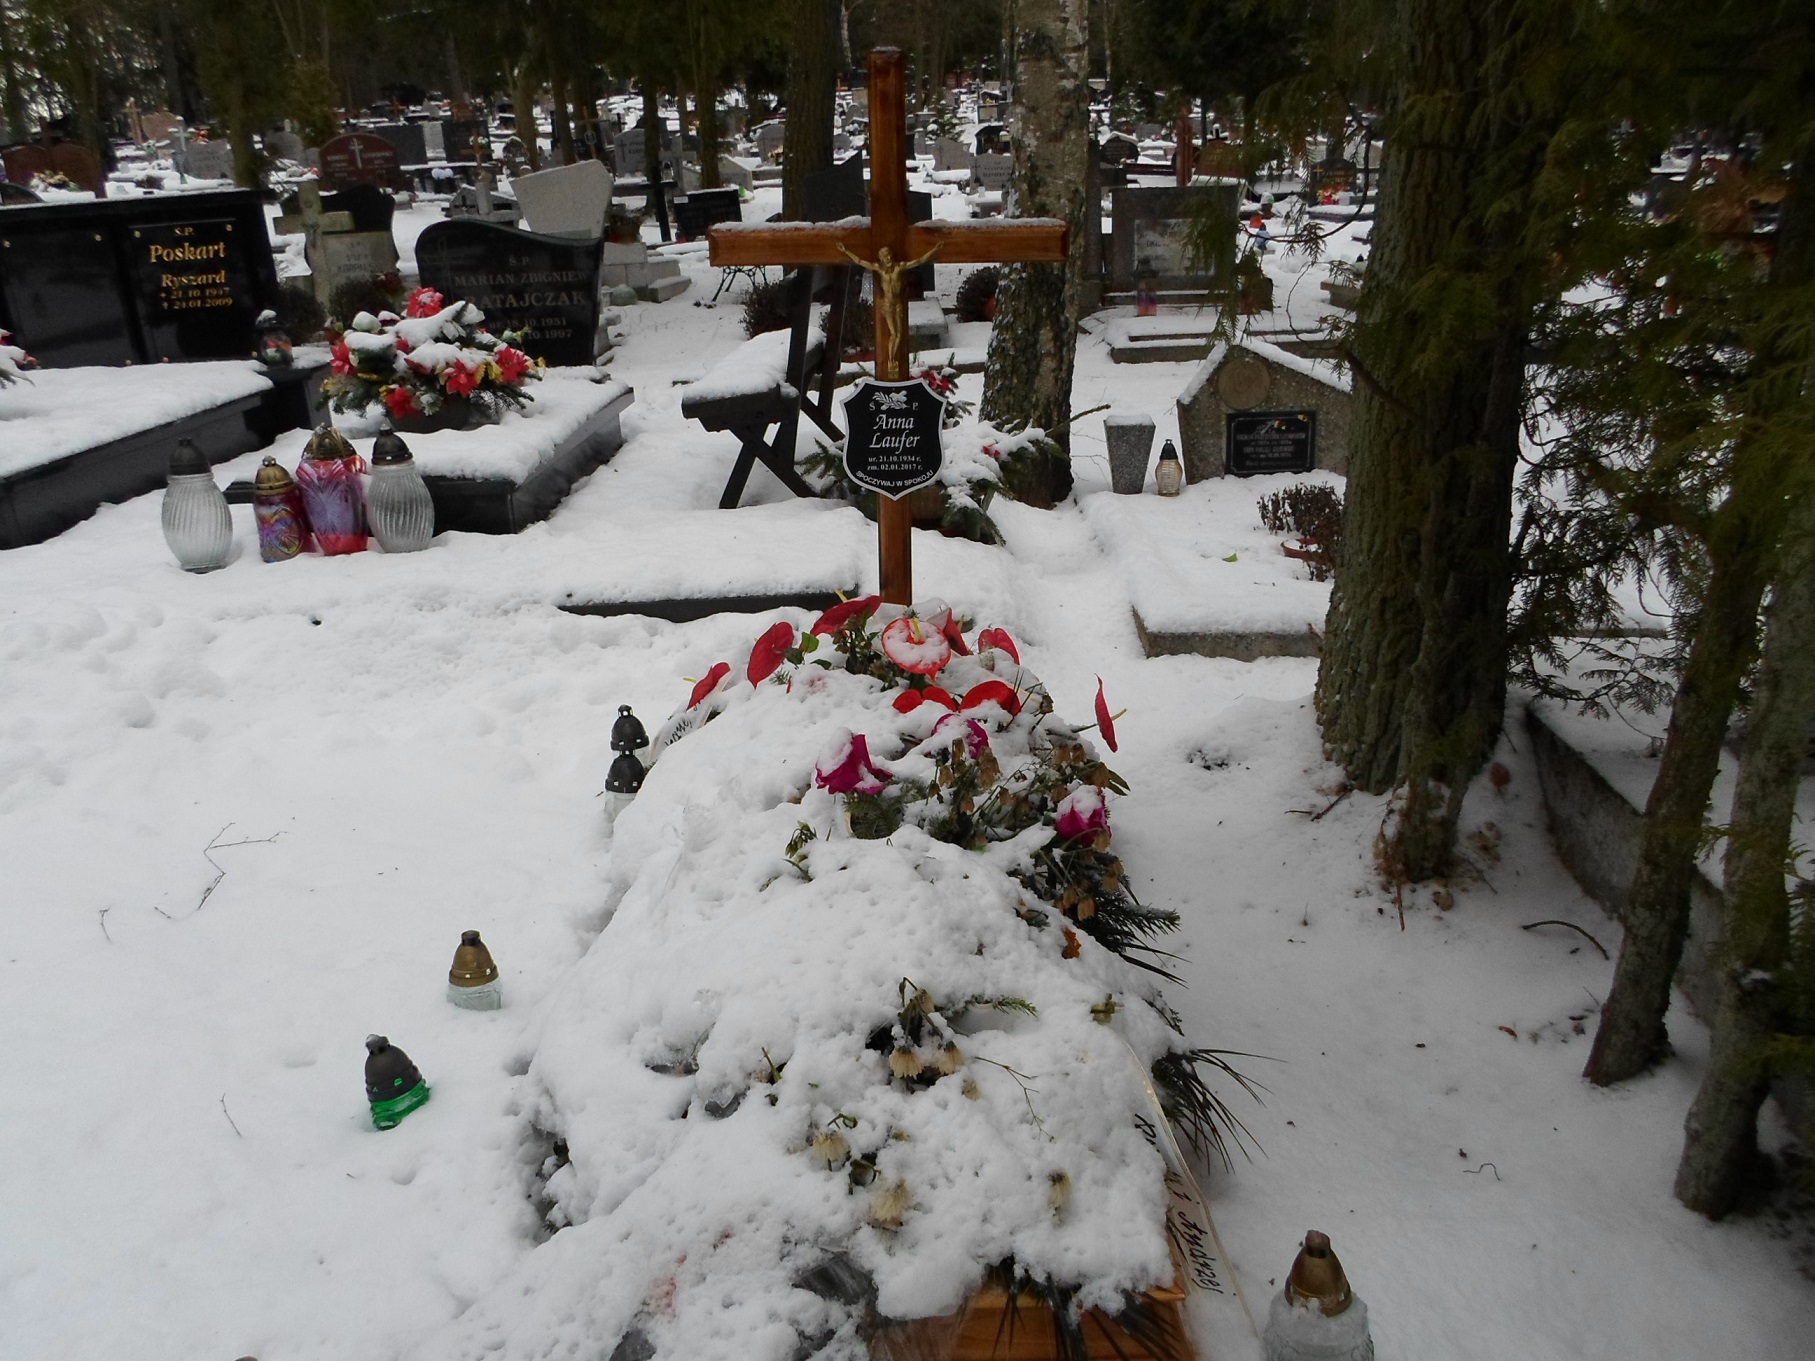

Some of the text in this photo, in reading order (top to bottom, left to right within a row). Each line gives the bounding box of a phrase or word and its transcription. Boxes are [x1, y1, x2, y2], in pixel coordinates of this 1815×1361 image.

[149, 242, 226, 263] Poskart
[161, 270, 226, 289] Ryszard
[454, 270, 590, 287] MARIAN ZBIGNIEW
[873, 413, 915, 430] Anna
[869, 430, 920, 455] Laufer
[855, 470, 895, 487] SPOCZYWAJ
[904, 469, 934, 486] SPOKOJU
